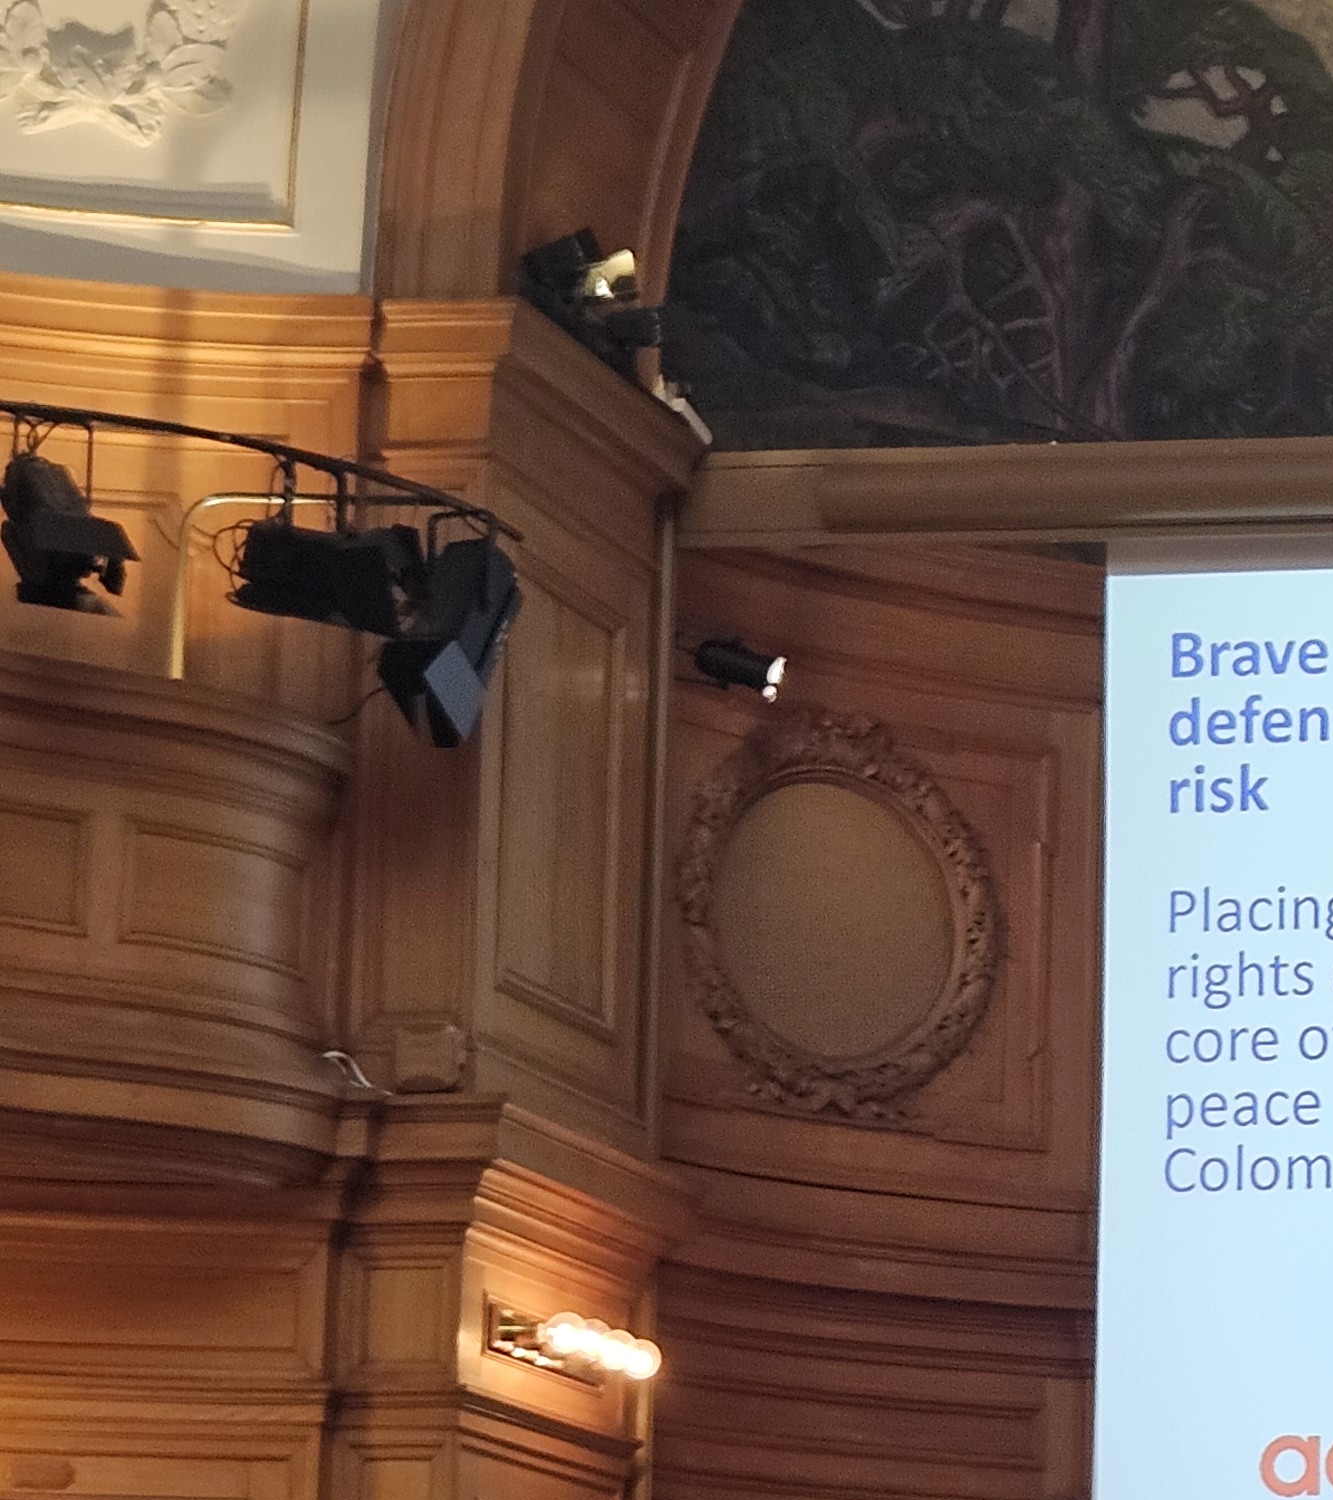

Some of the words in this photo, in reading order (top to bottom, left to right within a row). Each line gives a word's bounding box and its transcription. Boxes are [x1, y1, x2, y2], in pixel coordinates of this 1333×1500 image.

[1172, 633, 1328, 678] Brave
[1170, 764, 1269, 813] risk
[1169, 951, 1313, 1009] rights
[1167, 1028, 1278, 1063] core
[1167, 1091, 1320, 1140] peace
